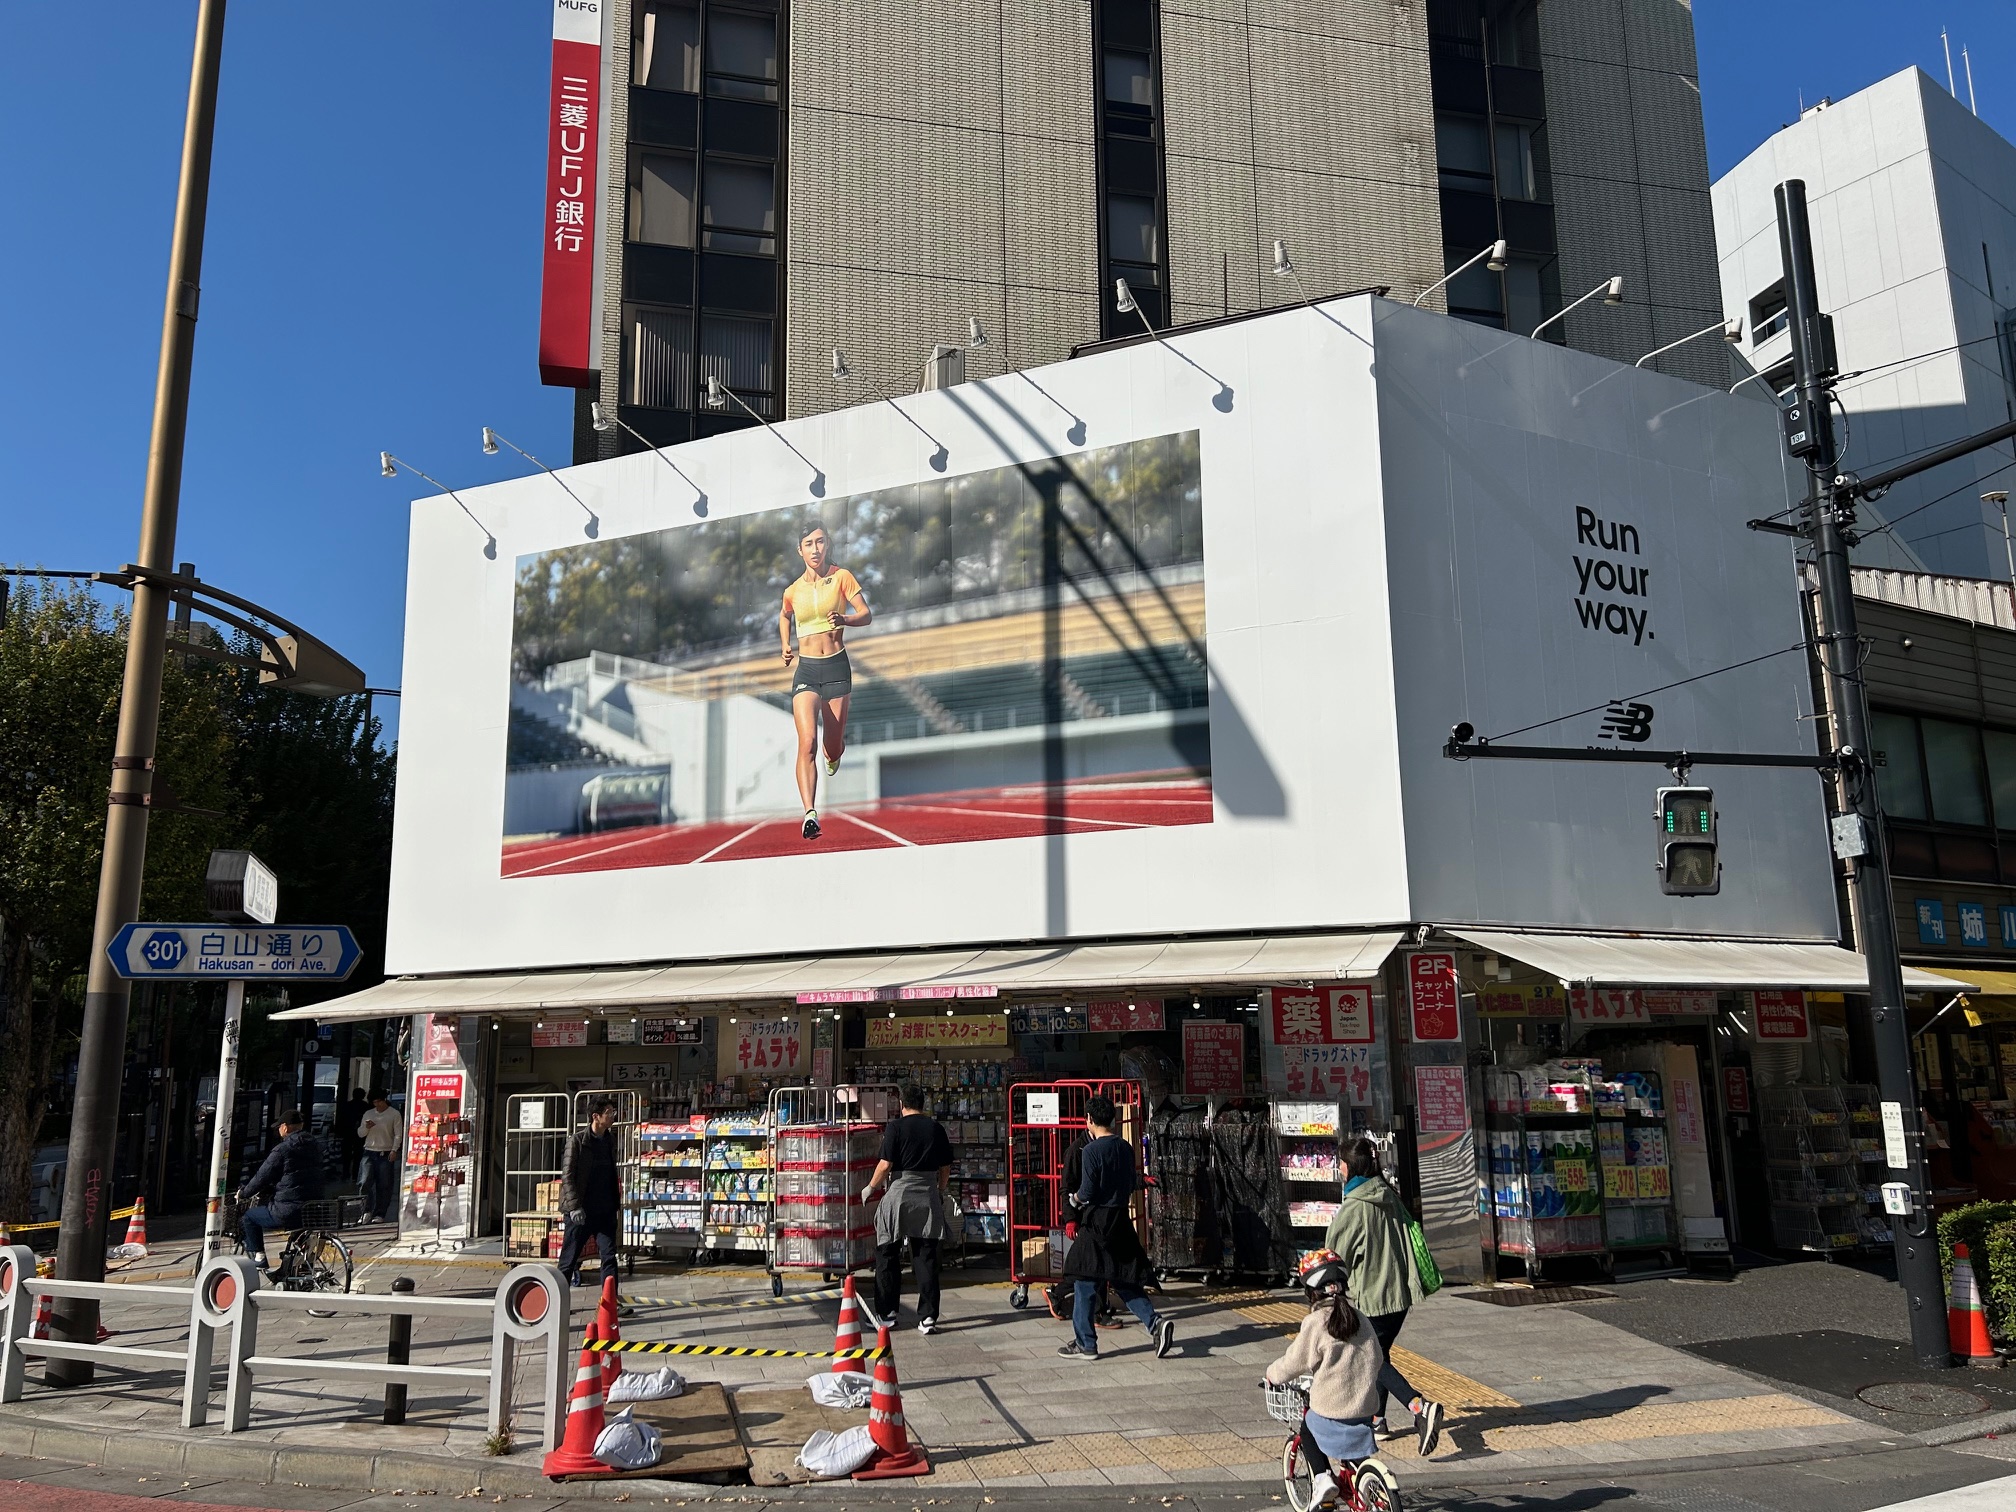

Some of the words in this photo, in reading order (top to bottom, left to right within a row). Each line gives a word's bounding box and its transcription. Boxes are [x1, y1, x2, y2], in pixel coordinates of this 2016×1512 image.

[558, 0, 598, 13] MUFG
[554, 76, 589, 253] 三菱UFJ銀行
[1576, 506, 1640, 555] Run
[1572, 556, 1649, 597] your
[1574, 598, 1655, 647] way.
[1919, 906, 1944, 939] 新刊
[147, 940, 182, 961] 301
[200, 932, 324, 957] 白山通り
[300, 957, 327, 972] Ave.
[1417, 958, 1448, 975] 2F
[1414, 980, 1453, 990] キャット
[1533, 986, 1554, 998] 2F
[1416, 990, 1444, 1000] フード
[1416, 1001, 1454, 1011] コーナー
[1760, 1004, 1800, 1017] 男性化粧品
[1091, 1011, 1160, 1027] キムラヤ
[1281, 995, 1322, 1035] 薬
[752, 1021, 799, 1036] ドラッグストア
[873, 1019, 893, 1032] カゼ
[938, 1020, 1006, 1039] マスクコーナー
[1186, 1026, 1240, 1040] 2階商品のご案内
[1762, 1021, 1796, 1034] 家電製品
[1292, 1034, 1324, 1044] キムラヤ
[738, 1036, 799, 1070] キムラヤ
[1303, 1047, 1367, 1063] ドラッグストア
[616, 1065, 667, 1080] ちふれ
[419, 1077, 431, 1087] 1F
[438, 1077, 459, 1086] キムラヤ
[1287, 1065, 1370, 1102] キムラヤ
[1728, 1070, 1744, 1110] たばこ
[1567, 1167, 1584, 1187] 558
[1616, 1168, 1635, 1193] 378
[1651, 1167, 1669, 1192] 398
[1305, 1214, 1327, 1224] 138
